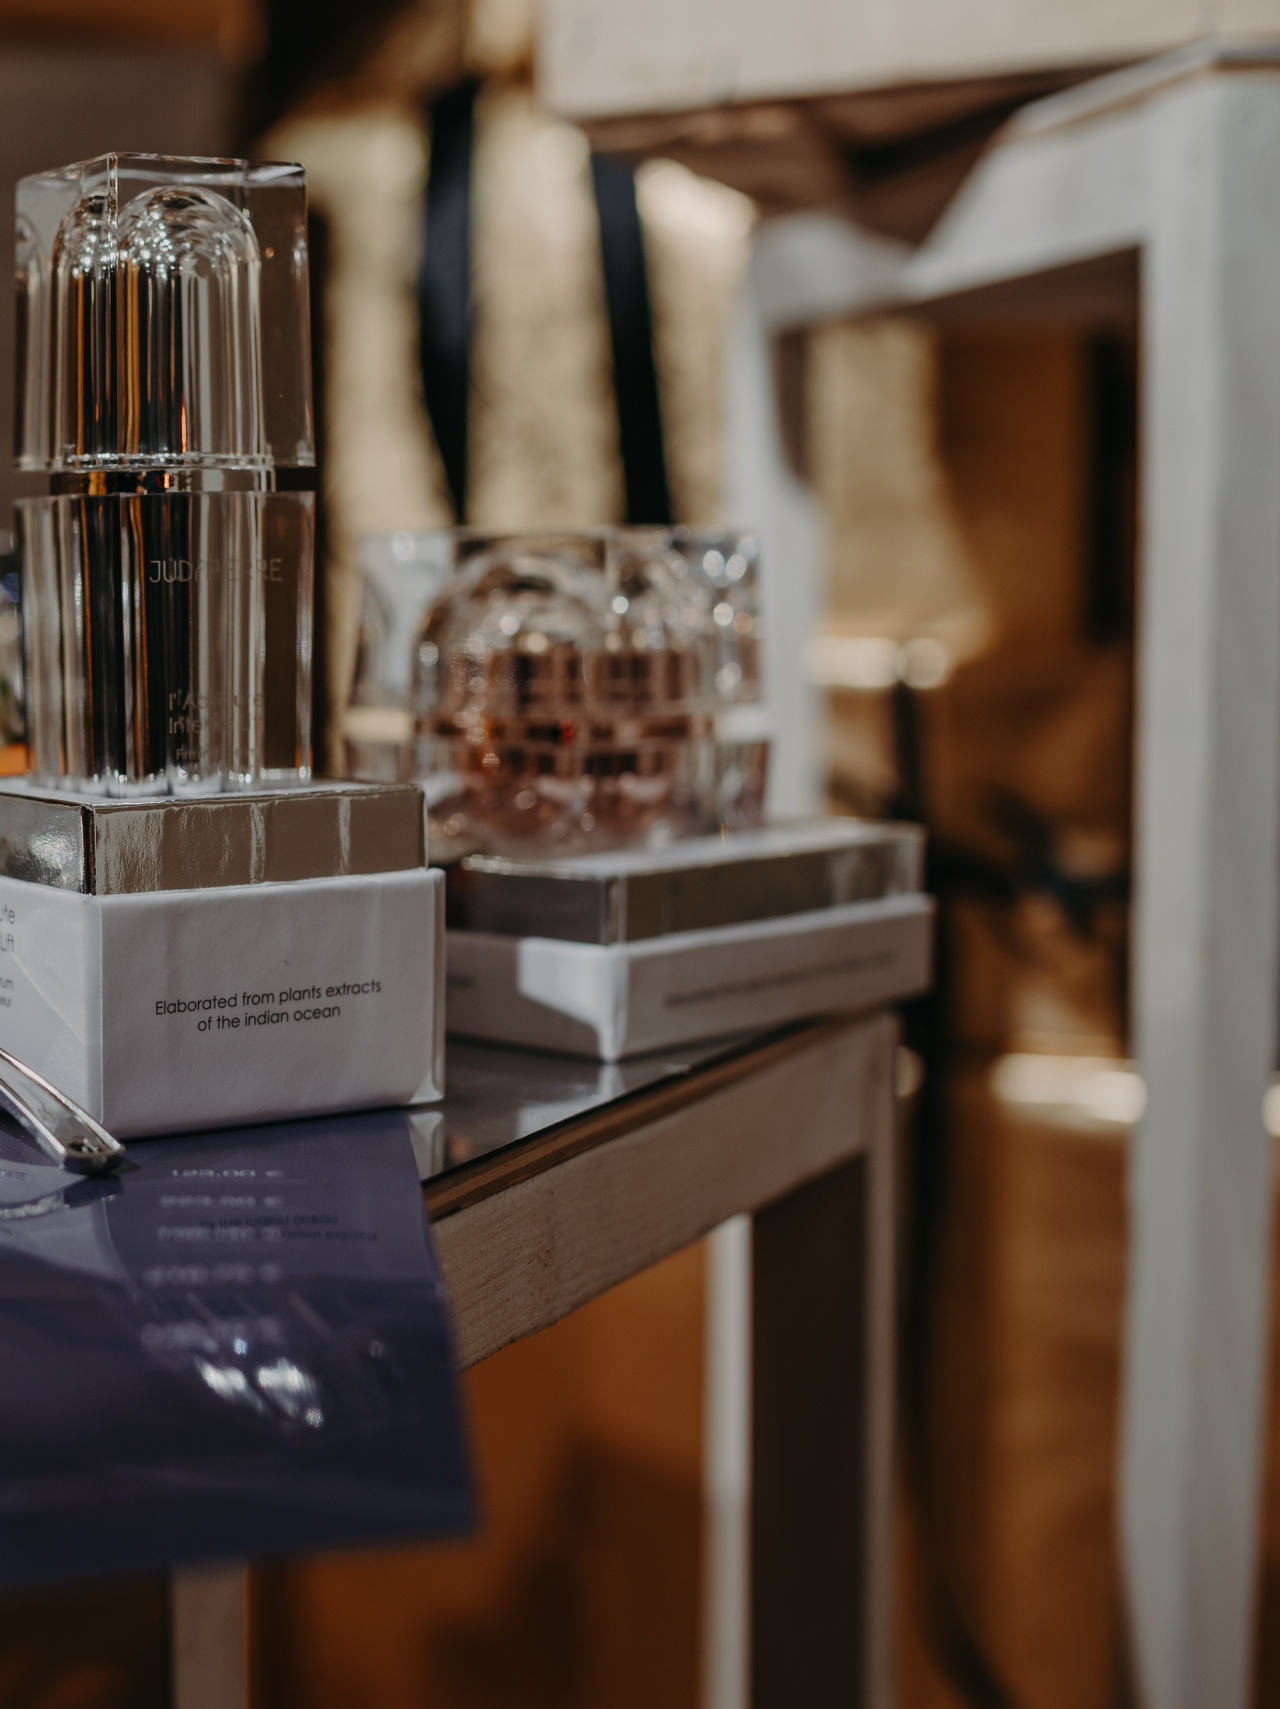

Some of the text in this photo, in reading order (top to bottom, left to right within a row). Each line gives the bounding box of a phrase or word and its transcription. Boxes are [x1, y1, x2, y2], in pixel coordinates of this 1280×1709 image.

[0, 932, 15, 954] Lift
[155, 979, 382, 1015] Elaborated from plants extracts
[197, 1005, 341, 1032] of the indian ocean
